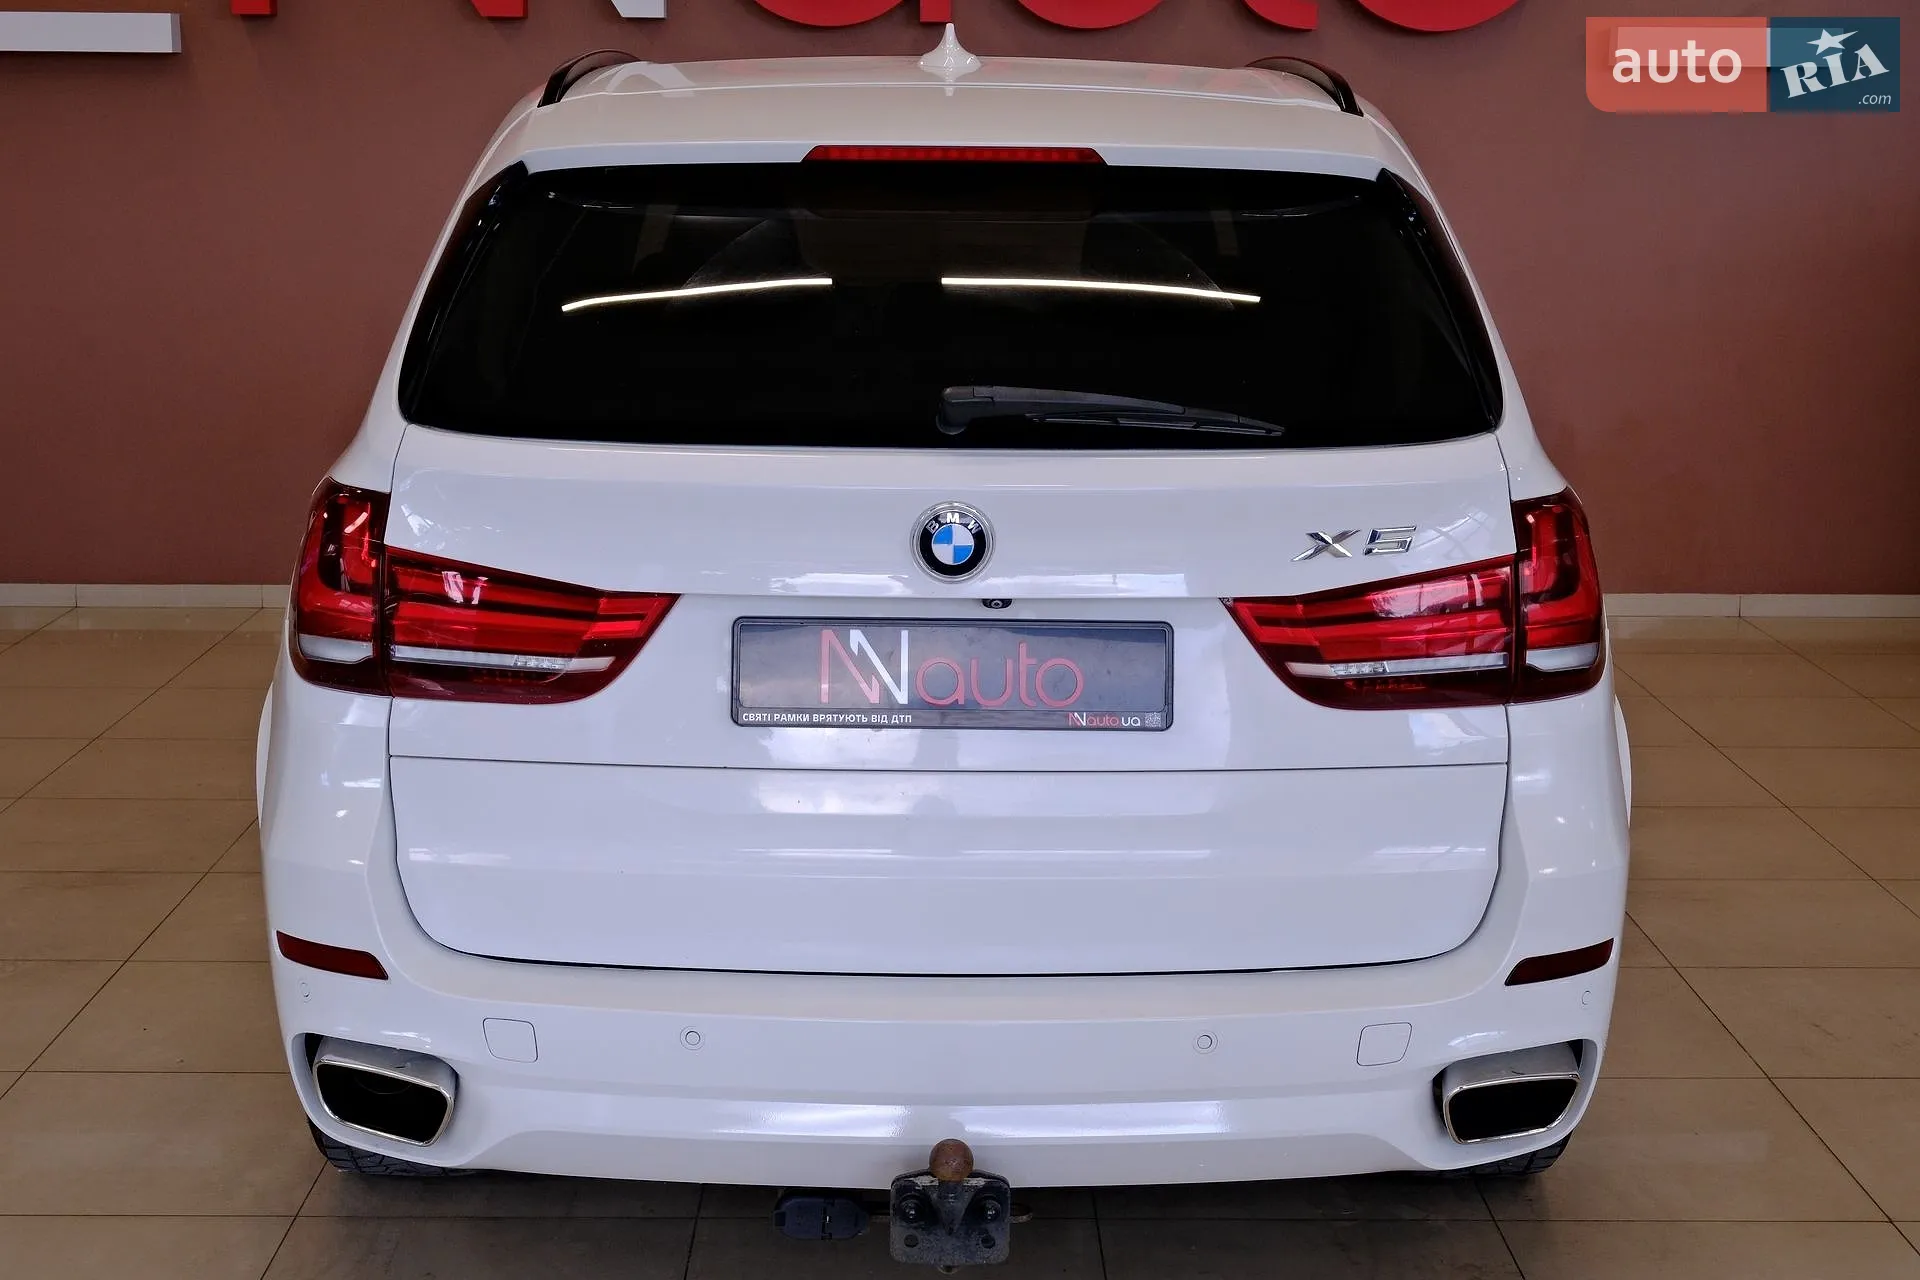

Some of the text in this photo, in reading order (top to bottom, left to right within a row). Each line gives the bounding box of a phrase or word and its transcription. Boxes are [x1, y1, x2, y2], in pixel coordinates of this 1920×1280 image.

[926, 512, 982, 534] BMW
[1290, 526, 1417, 560] X5
[742, 713, 912, 723] СВЯТІ РАМКИ ВРЯТУЮТЬ ВІД ДТП
